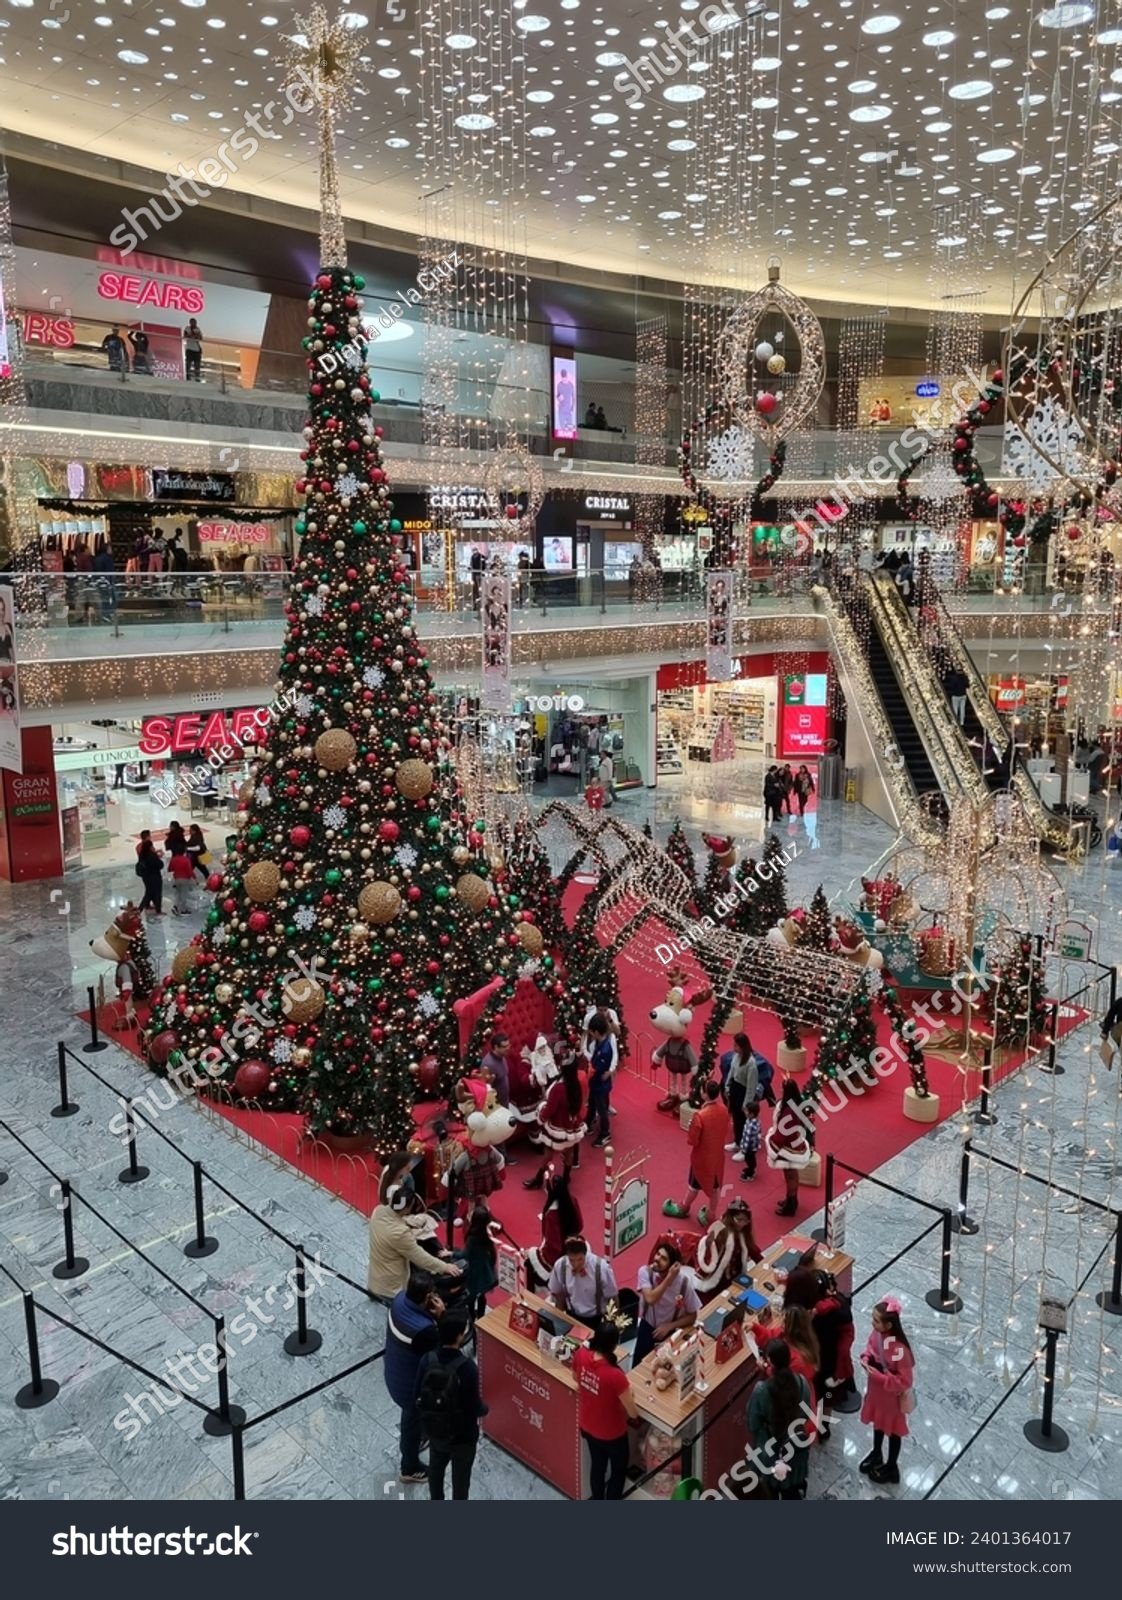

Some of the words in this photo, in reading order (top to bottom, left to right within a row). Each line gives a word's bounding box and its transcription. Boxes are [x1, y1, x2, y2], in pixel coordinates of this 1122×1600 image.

[98, 272, 204, 313] SEARS
[430, 495, 498, 508] CRISTAL
[585, 496, 629, 510] CRISTAL
[403, 520, 431, 529] MIDO
[198, 522, 269, 543] SEARS
[524, 694, 585, 712] TOTTO
[139, 707, 270, 754] SEAR
[12, 777, 49, 790] GRAN
[14, 787, 49, 798] VENTA
